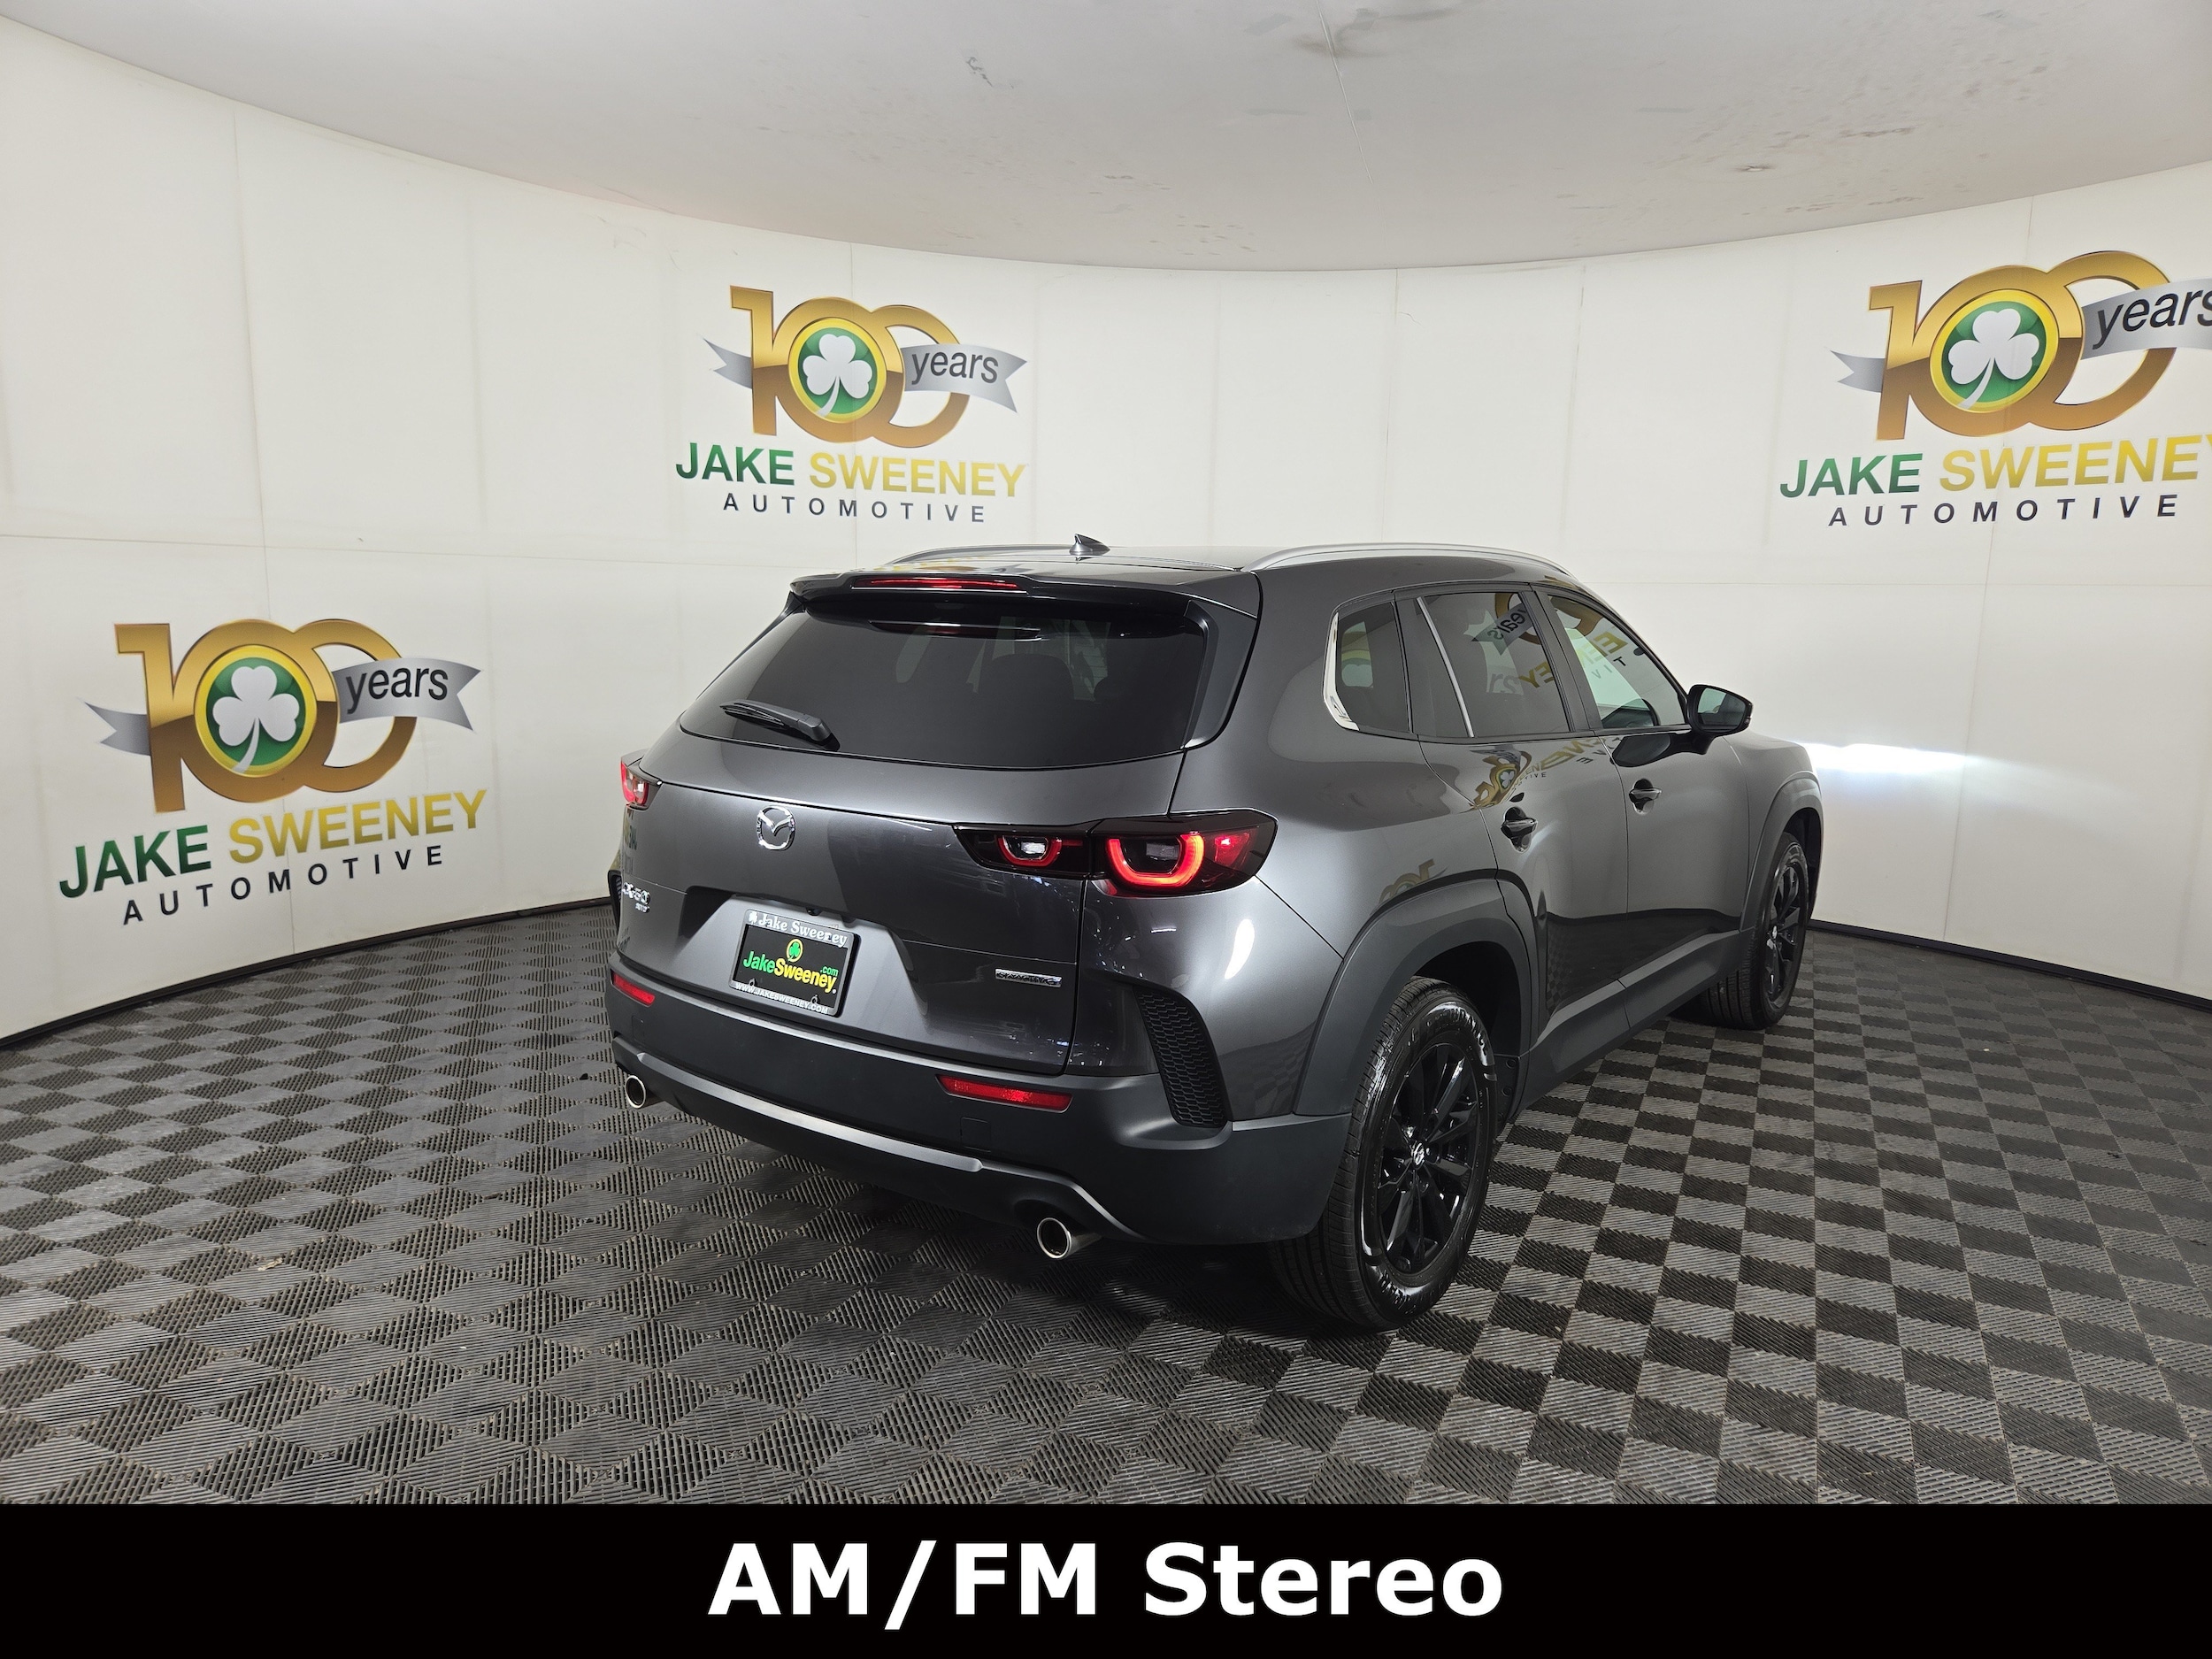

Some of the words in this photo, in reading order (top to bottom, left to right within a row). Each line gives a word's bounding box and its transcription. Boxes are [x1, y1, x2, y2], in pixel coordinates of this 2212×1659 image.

[1869, 250, 2177, 441] 100
[2092, 289, 2212, 349] years
[730, 285, 971, 448] 100
[910, 350, 1000, 386] years
[675, 442, 795, 486] JAKE
[809, 451, 1026, 497] SWEENEY
[1779, 452, 1923, 498] JAKE
[1939, 433, 2212, 492] SWEENE
[723, 492, 984, 522] AUTOMOTIVE
[1828, 494, 2177, 526] AUTOMOTIVE
[114, 618, 417, 813] 100
[346, 666, 449, 714] years
[59, 825, 211, 898] JAKE
[229, 788, 488, 864] SWEENEY
[123, 845, 442, 925] AUTOMOTIVE
[758, 913, 788, 931] Jake
[735, 982, 829, 1015] WWW.JAKESWEENEY.COM
